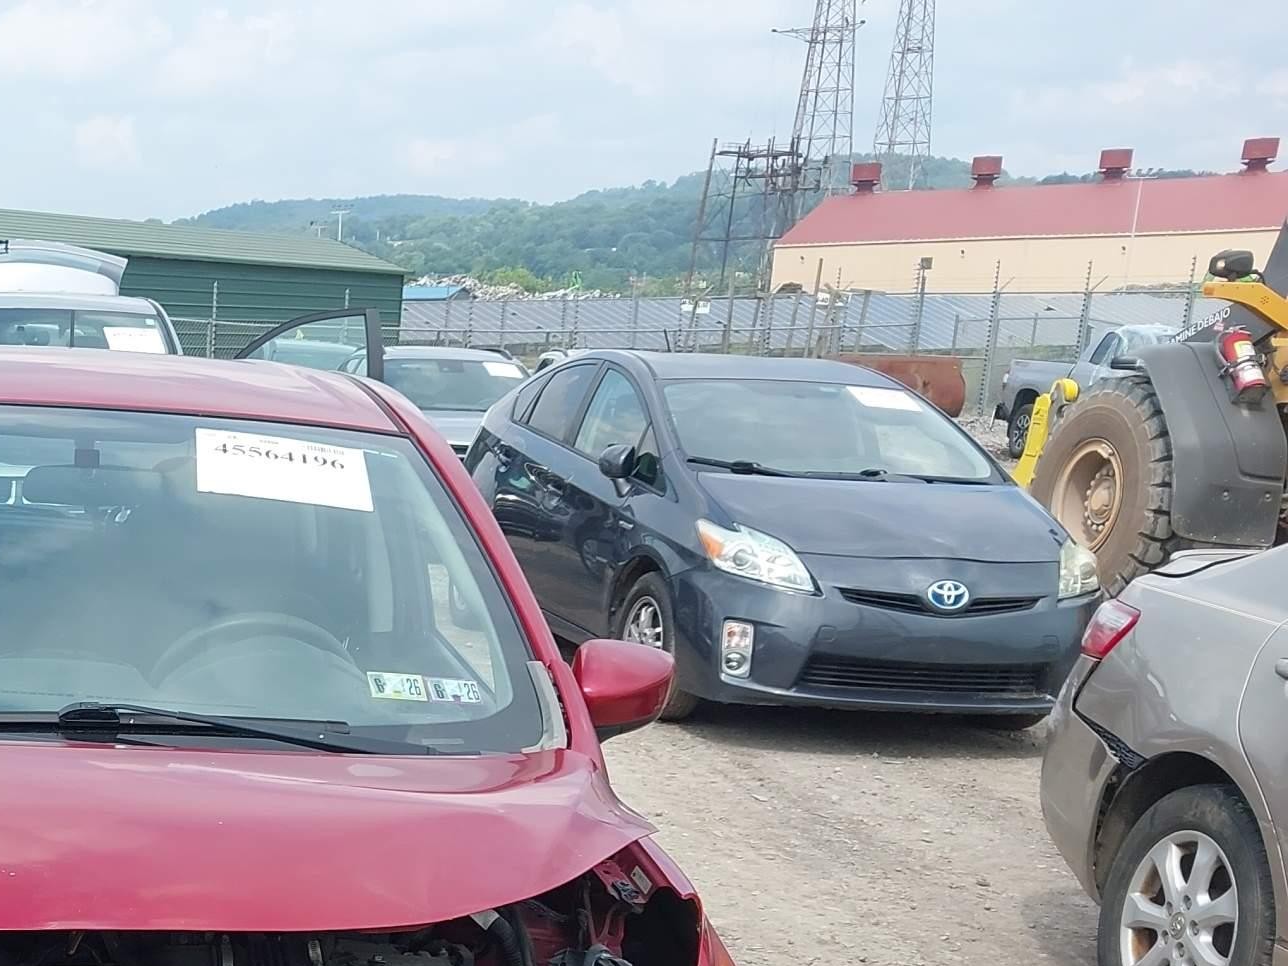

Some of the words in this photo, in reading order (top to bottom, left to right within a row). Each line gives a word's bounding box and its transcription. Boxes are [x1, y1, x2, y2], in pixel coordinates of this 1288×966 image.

[1197, 307, 1231, 330] DEBAJO
[214, 443, 345, 470] 45564196
[406, 678, 422, 696] 26
[463, 683, 480, 700] 26
